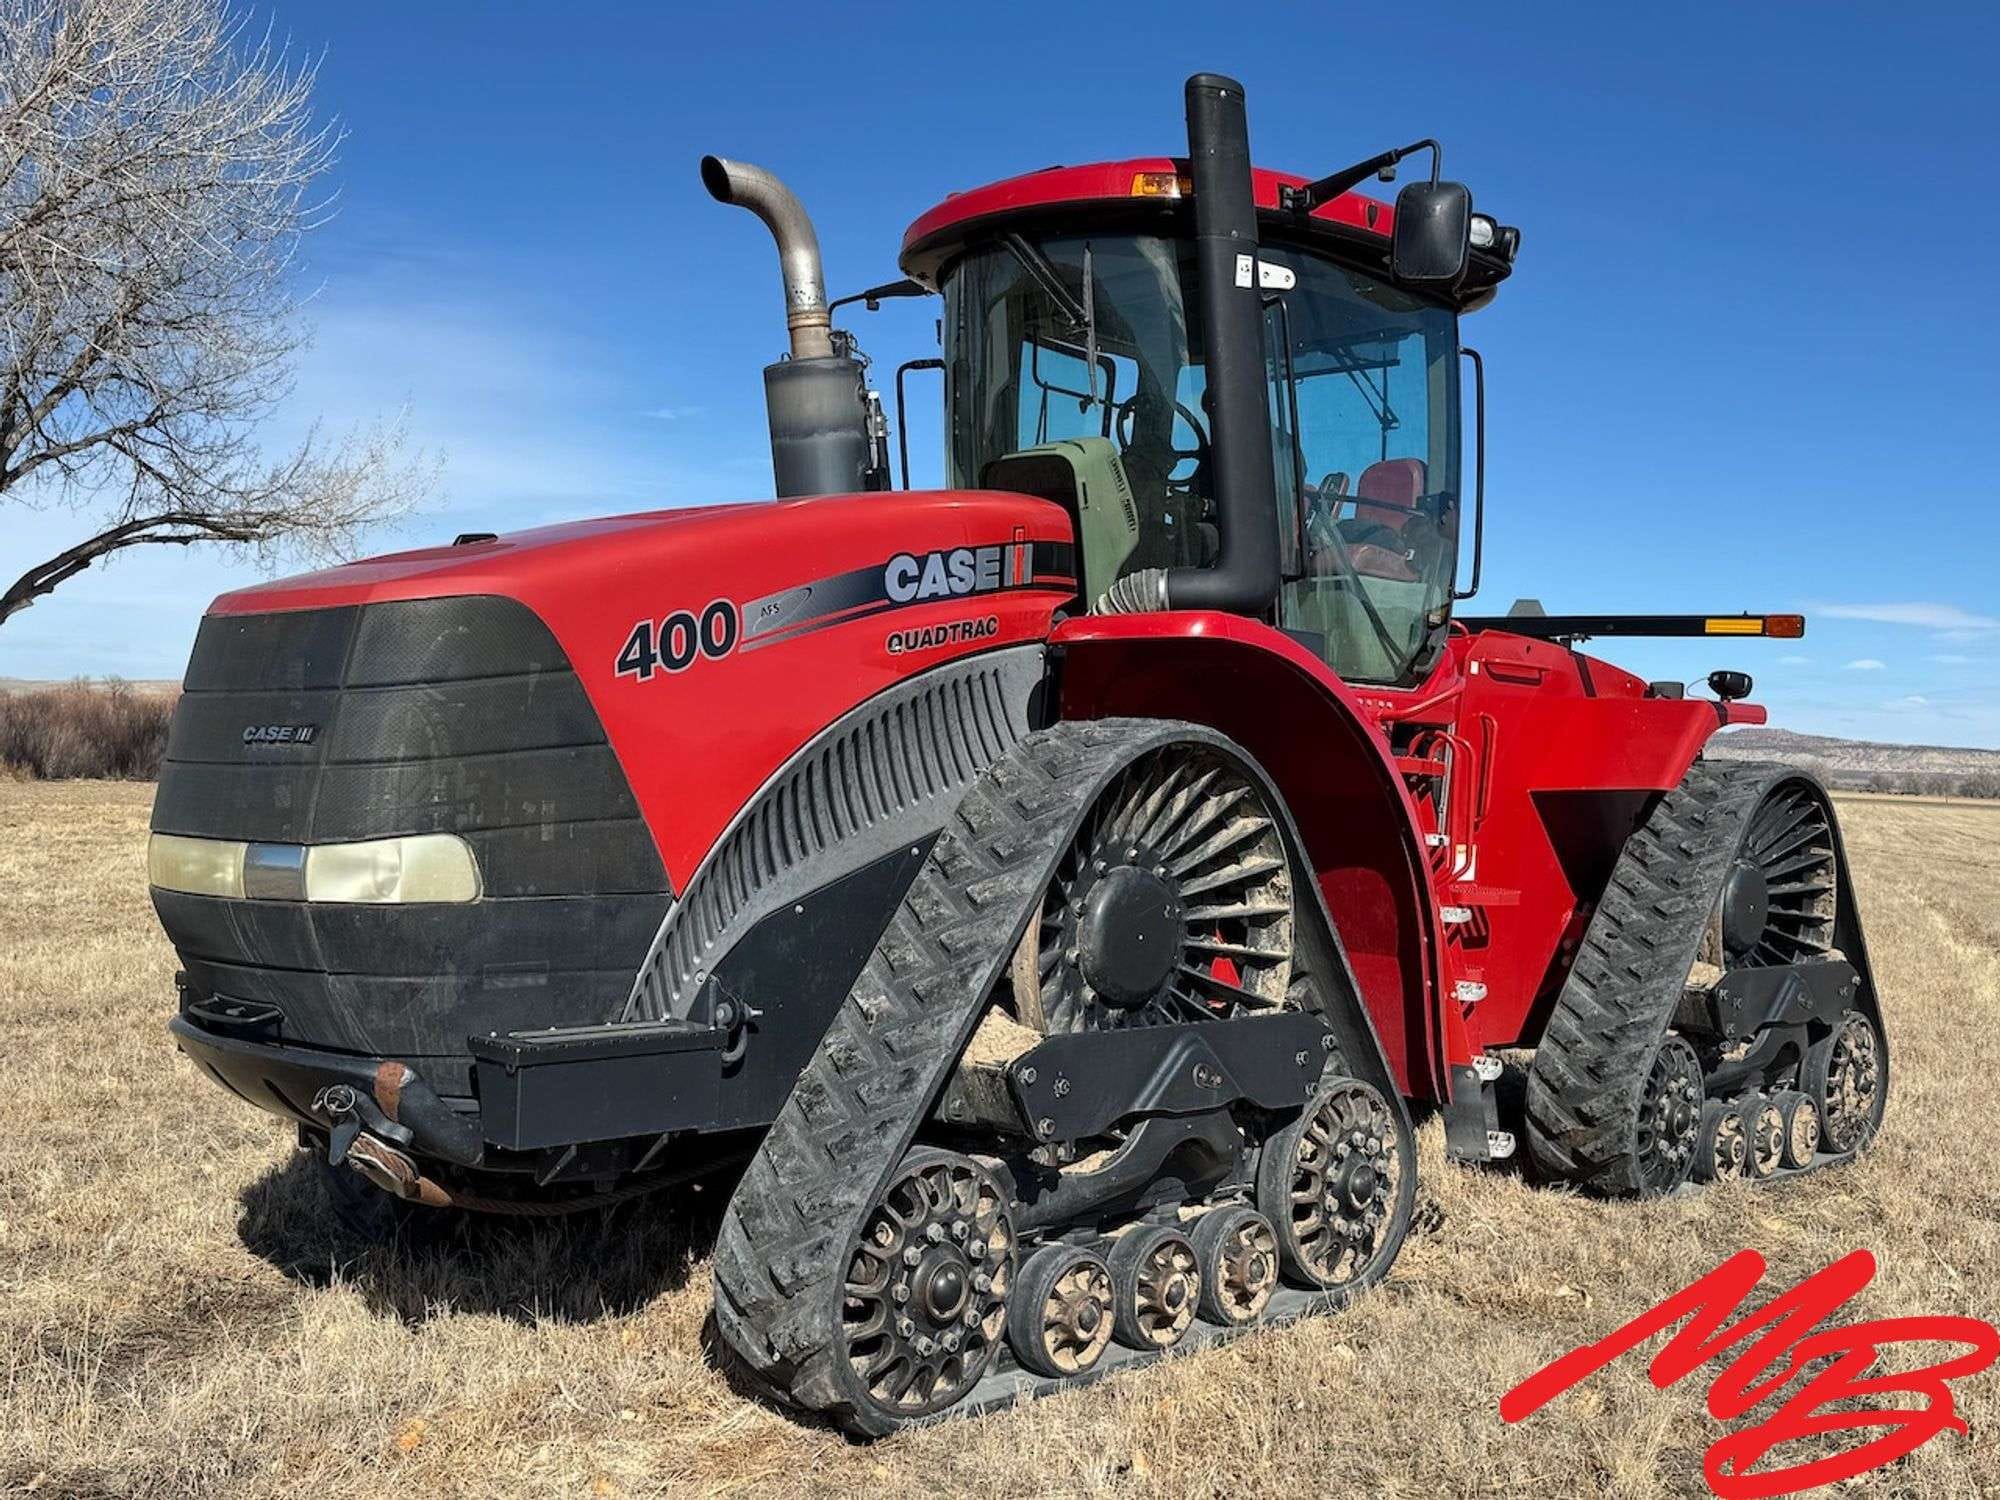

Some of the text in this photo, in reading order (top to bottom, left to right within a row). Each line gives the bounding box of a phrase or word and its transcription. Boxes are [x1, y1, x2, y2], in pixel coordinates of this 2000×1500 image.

[885, 547, 1000, 602] CASE
[760, 602, 780, 617] AFS
[615, 598, 739, 682] 400
[886, 615, 999, 654] QUADTRAC
[242, 726, 293, 741] CASE
